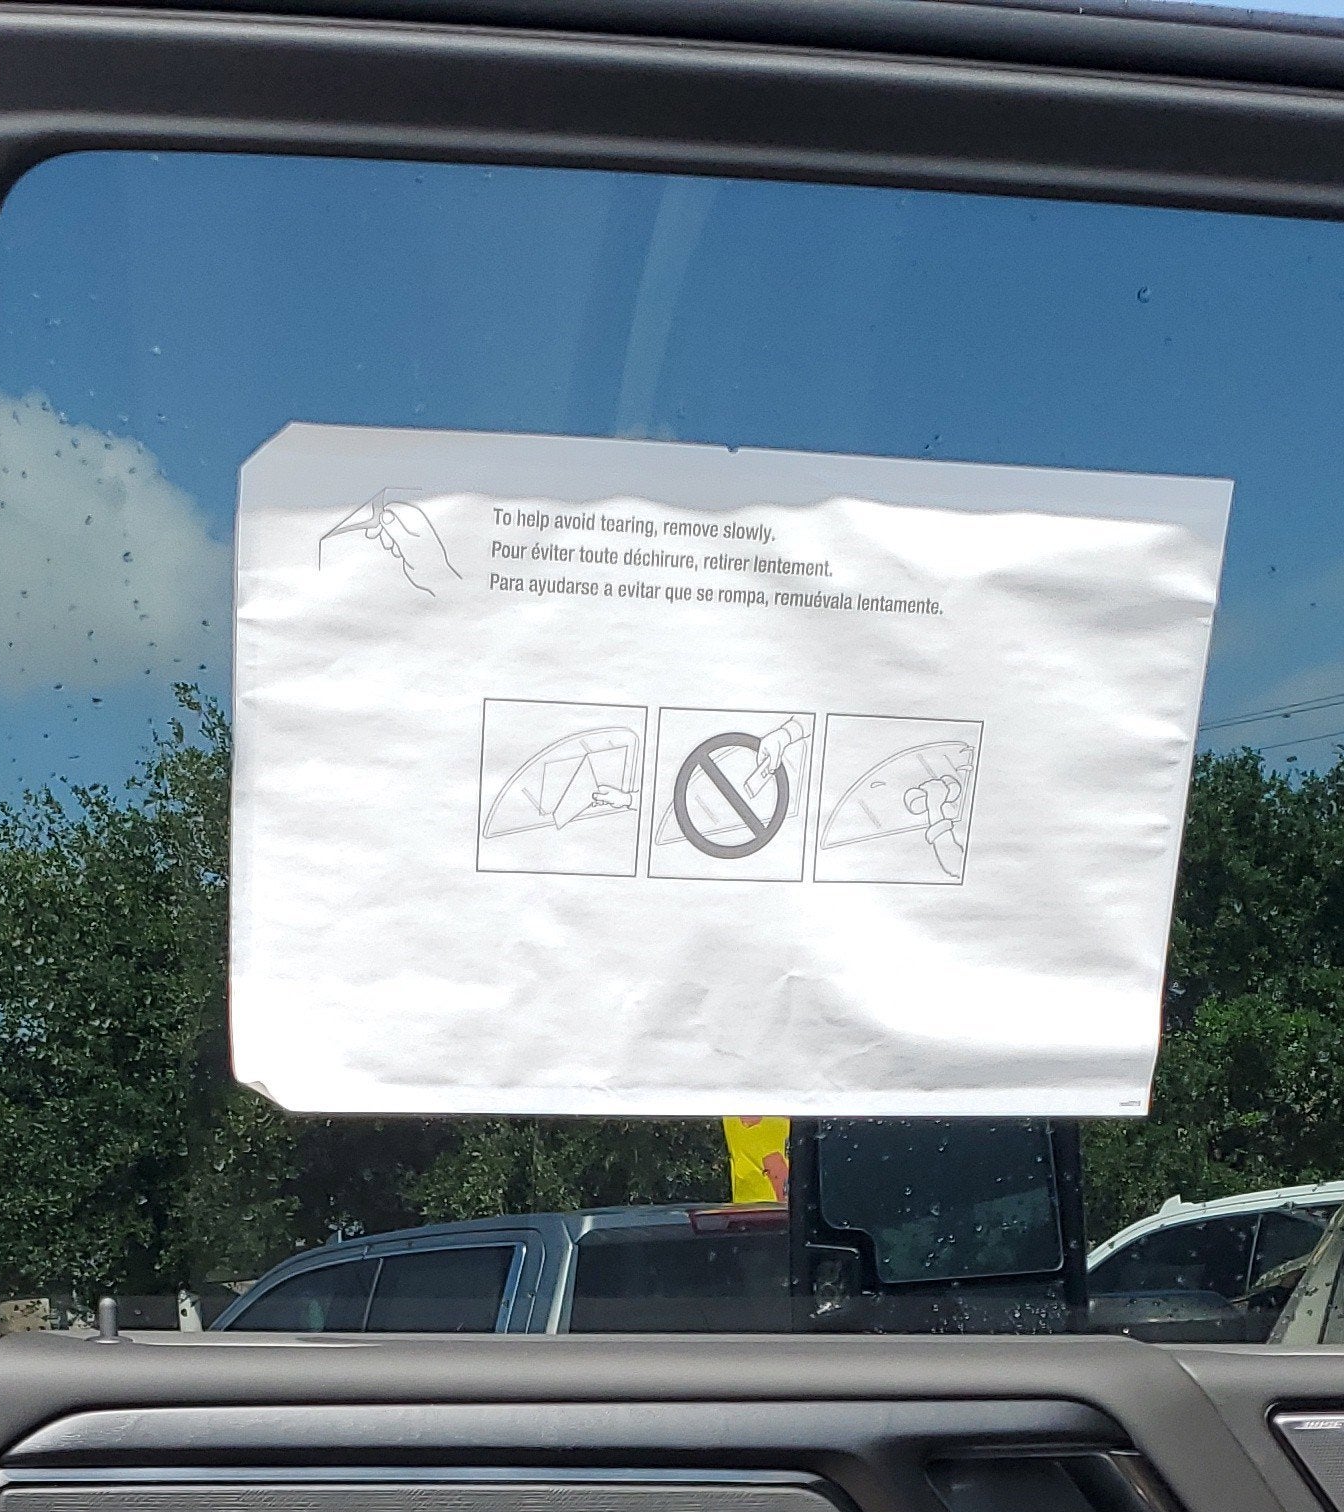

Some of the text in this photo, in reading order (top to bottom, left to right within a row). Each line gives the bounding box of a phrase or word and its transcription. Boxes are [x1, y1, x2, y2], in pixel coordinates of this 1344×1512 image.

[493, 507, 776, 545] To help avoid tearing, remove slowly.
[491, 540, 833, 578] Pour éviter toute déchirure, retirer lentement.
[489, 572, 944, 616] Para ayudarse a evitar que se rompa, remuévala lentamente.
